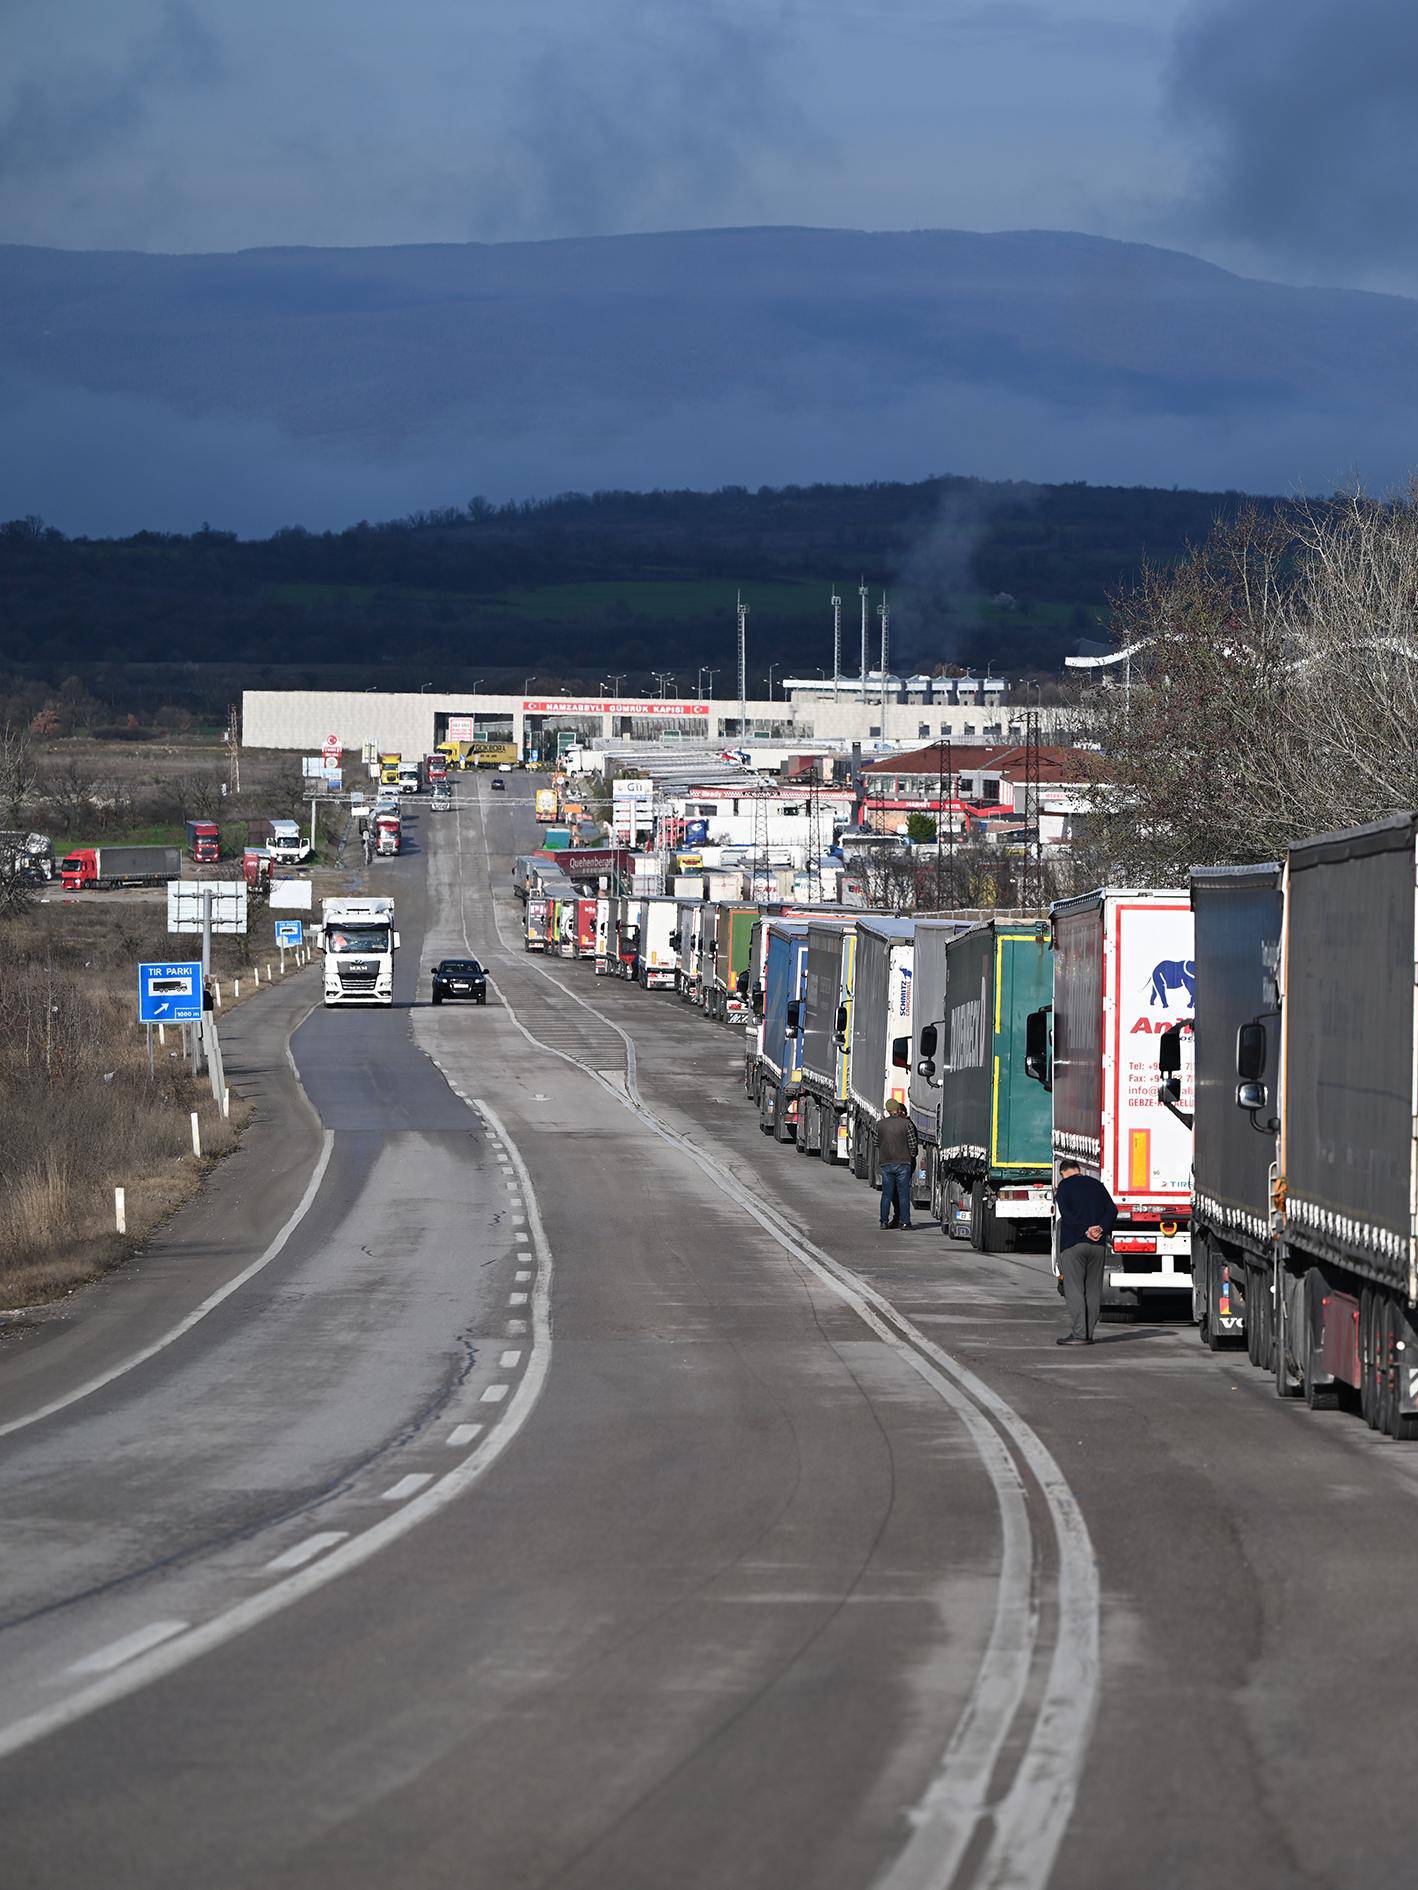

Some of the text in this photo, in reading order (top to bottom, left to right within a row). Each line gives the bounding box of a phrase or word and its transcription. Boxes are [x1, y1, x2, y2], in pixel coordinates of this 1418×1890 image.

[148, 967, 193, 976] TIR PARKI
[1129, 1062, 1145, 1070] Tel:
[1128, 1074, 1146, 1082] Fax:
